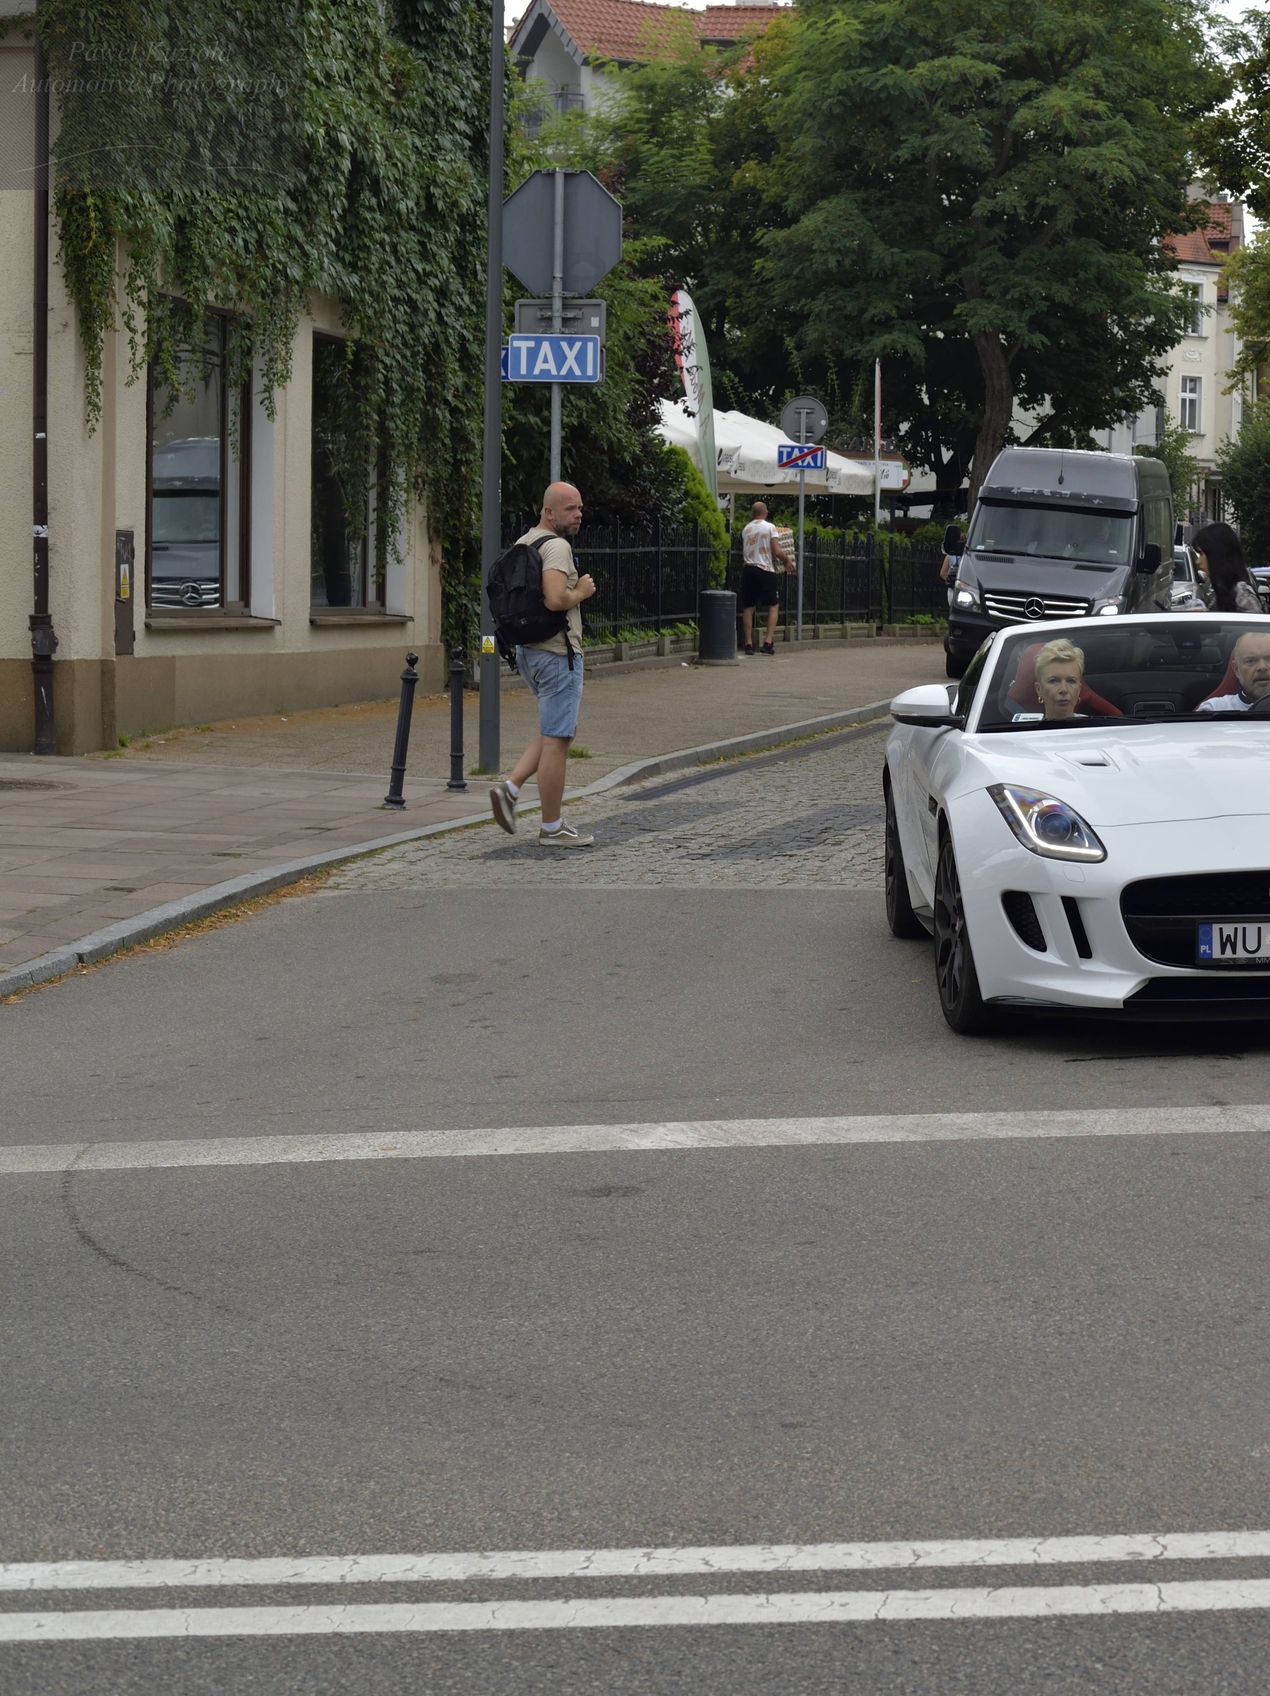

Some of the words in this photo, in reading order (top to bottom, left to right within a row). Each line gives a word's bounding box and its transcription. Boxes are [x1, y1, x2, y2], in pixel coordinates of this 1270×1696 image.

[513, 341, 594, 376] TAXI
[779, 447, 821, 467] TAXI
[1200, 945, 1211, 953] PL
[1219, 926, 1262, 955] WU
